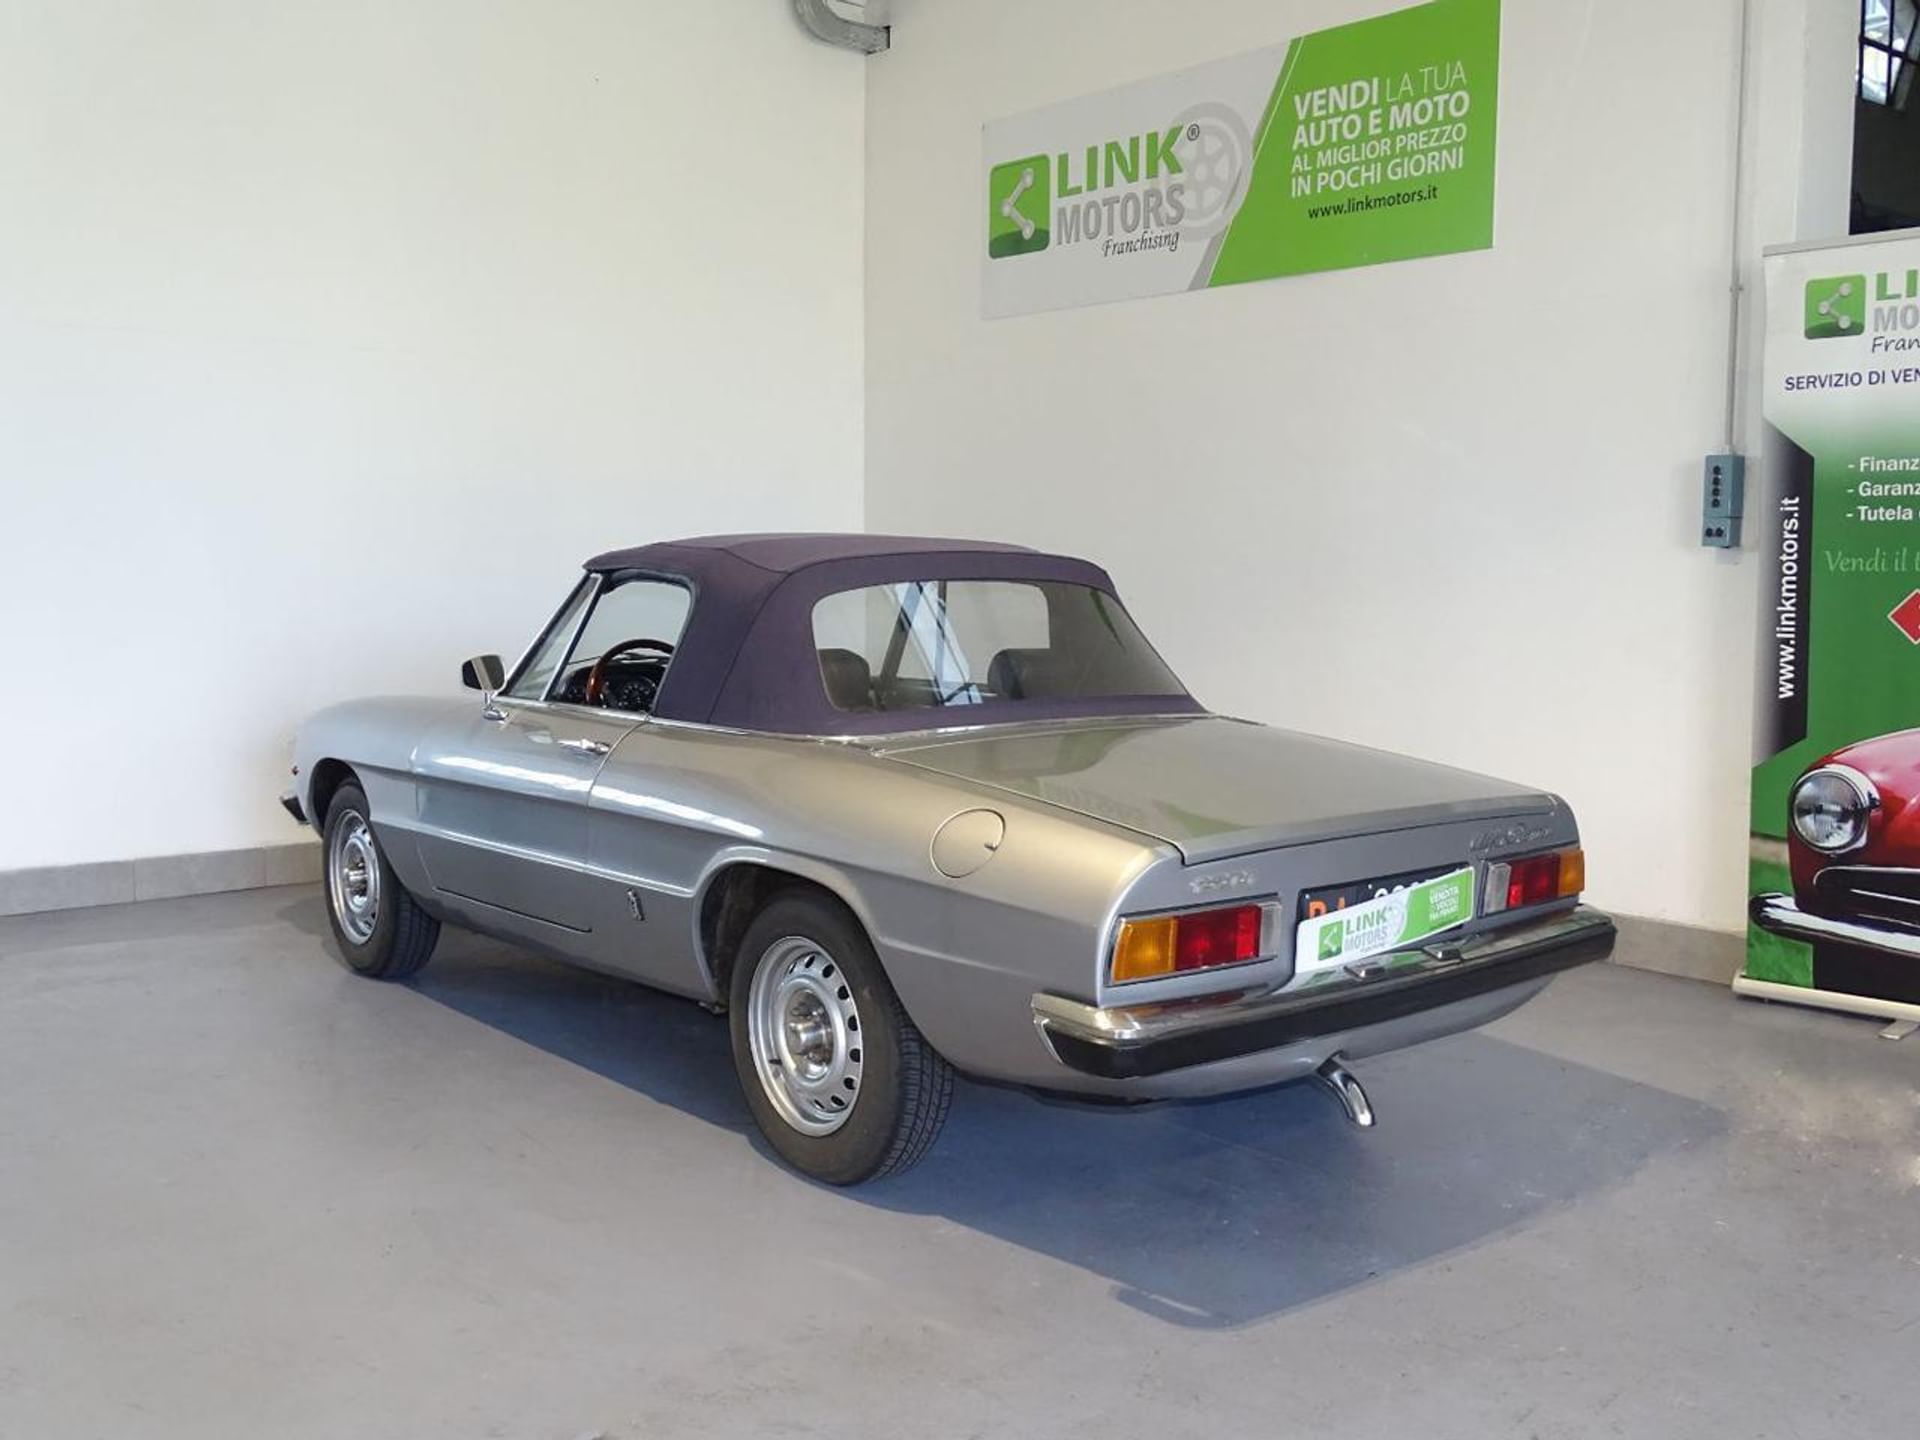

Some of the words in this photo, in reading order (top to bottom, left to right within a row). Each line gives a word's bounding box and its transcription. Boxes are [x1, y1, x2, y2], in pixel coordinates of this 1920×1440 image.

[1294, 77, 1379, 120] VENDI
[1386, 72, 1414, 102] LA
[1419, 60, 1467, 93] TUA
[1292, 114, 1362, 150] AUTO
[1368, 108, 1383, 135] E
[1389, 90, 1470, 131] MOTO
[1292, 153, 1312, 173] AL
[1317, 138, 1391, 168] MIGLIOR
[1396, 122, 1467, 153] PREZZO
[1292, 174, 1311, 198] IN
[1317, 162, 1381, 193] POCHI
[1387, 144, 1464, 180] GIORNI
[1056, 183, 1185, 245] MOTORS
[1308, 184, 1438, 219] www.linkmotors.it
[1102, 230, 1180, 257] Franchising
[1784, 372, 1862, 391] SERVIZIO
[1868, 370, 1886, 385] DI
[1857, 505, 1914, 521] Tutela
[1825, 547, 1887, 573] Vendi
[1894, 547, 1908, 573] il
[1776, 497, 1800, 699] www.linkmotors.it
[1345, 926, 1388, 950] MOTORS
